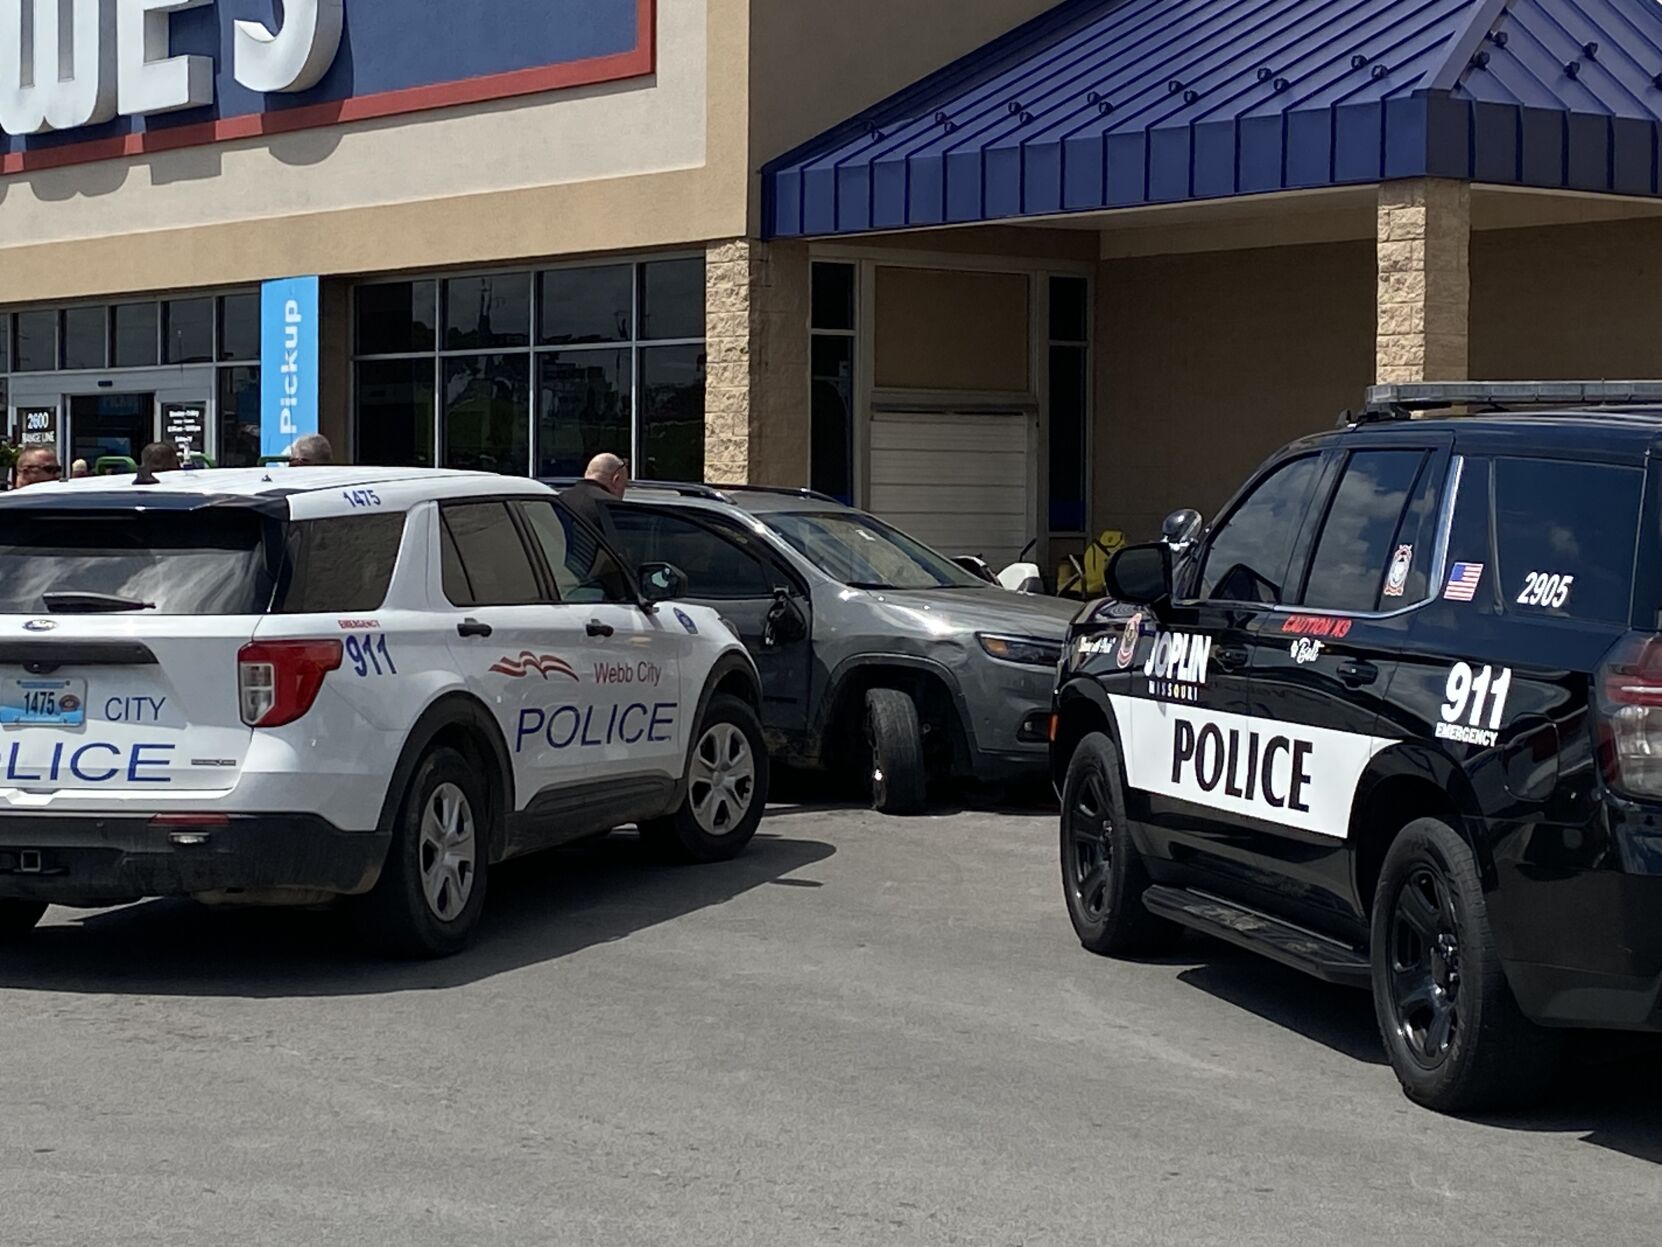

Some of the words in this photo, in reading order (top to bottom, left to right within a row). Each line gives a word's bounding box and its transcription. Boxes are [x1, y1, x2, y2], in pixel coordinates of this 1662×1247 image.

[280, 299, 302, 434] Pickup
[343, 490, 381, 508] 1475
[1517, 571, 1574, 608] 2905
[1281, 614, 1333, 635] CAUTION
[346, 633, 397, 677] 911
[594, 661, 634, 684] Webb
[637, 660, 662, 687] City
[1143, 631, 1212, 684] JOPLIN
[24, 691, 55, 715] 1475
[105, 696, 166, 721] CITY
[1148, 680, 1198, 701] MISSOURI
[1441, 661, 1512, 730] 911
[515, 702, 678, 753] POLICE
[1434, 722, 1498, 748] EMERGENCY
[0, 741, 176, 782] LICE
[1171, 718, 1313, 813] POLICE
